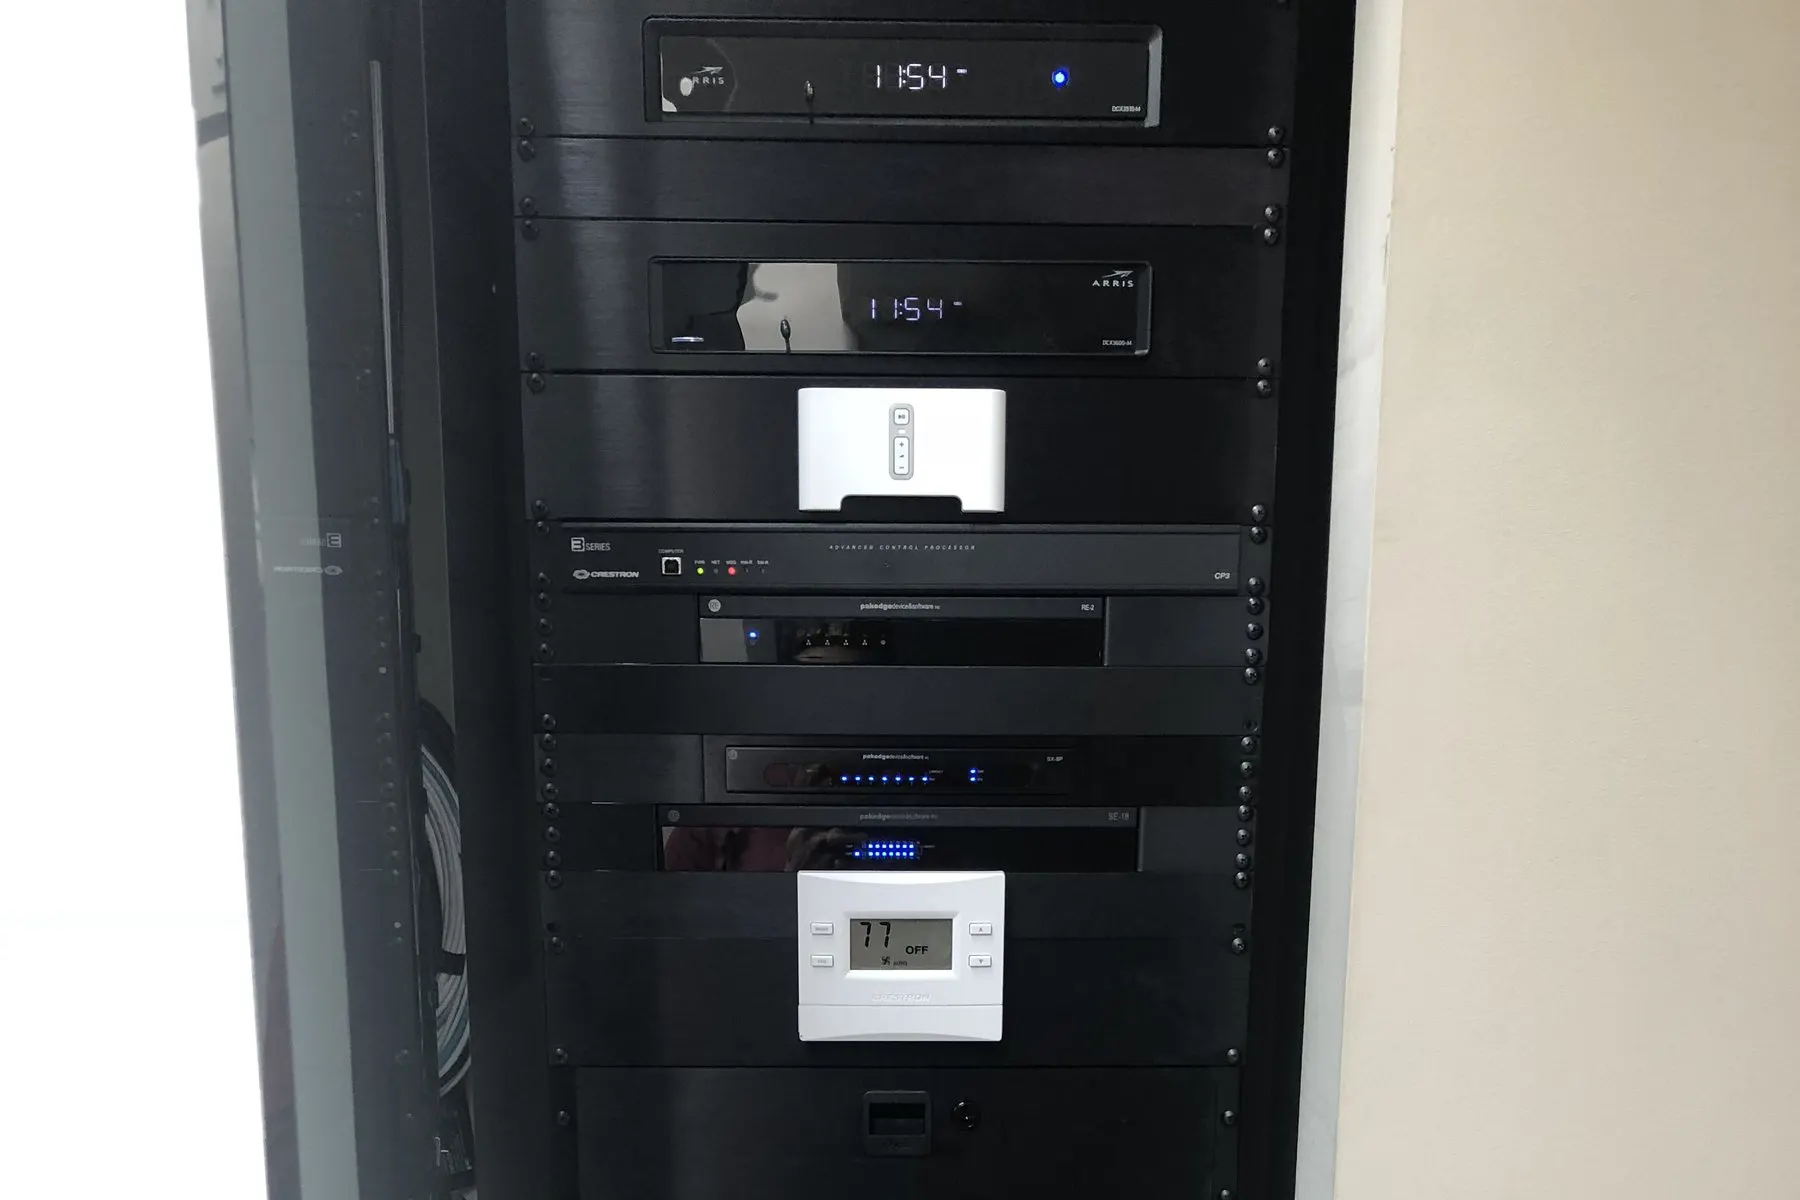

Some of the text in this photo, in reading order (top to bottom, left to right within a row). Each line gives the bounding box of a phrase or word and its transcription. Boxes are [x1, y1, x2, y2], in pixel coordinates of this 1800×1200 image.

[684, 76, 725, 85] RRIS
[877, 63, 946, 90] 11:54
[1092, 279, 1134, 288] ARRIS
[872, 297, 943, 321] 11:54
[585, 543, 612, 551] SERIES
[1214, 572, 1231, 580] CP3
[860, 921, 891, 948] 77
[905, 945, 929, 955] OFF
